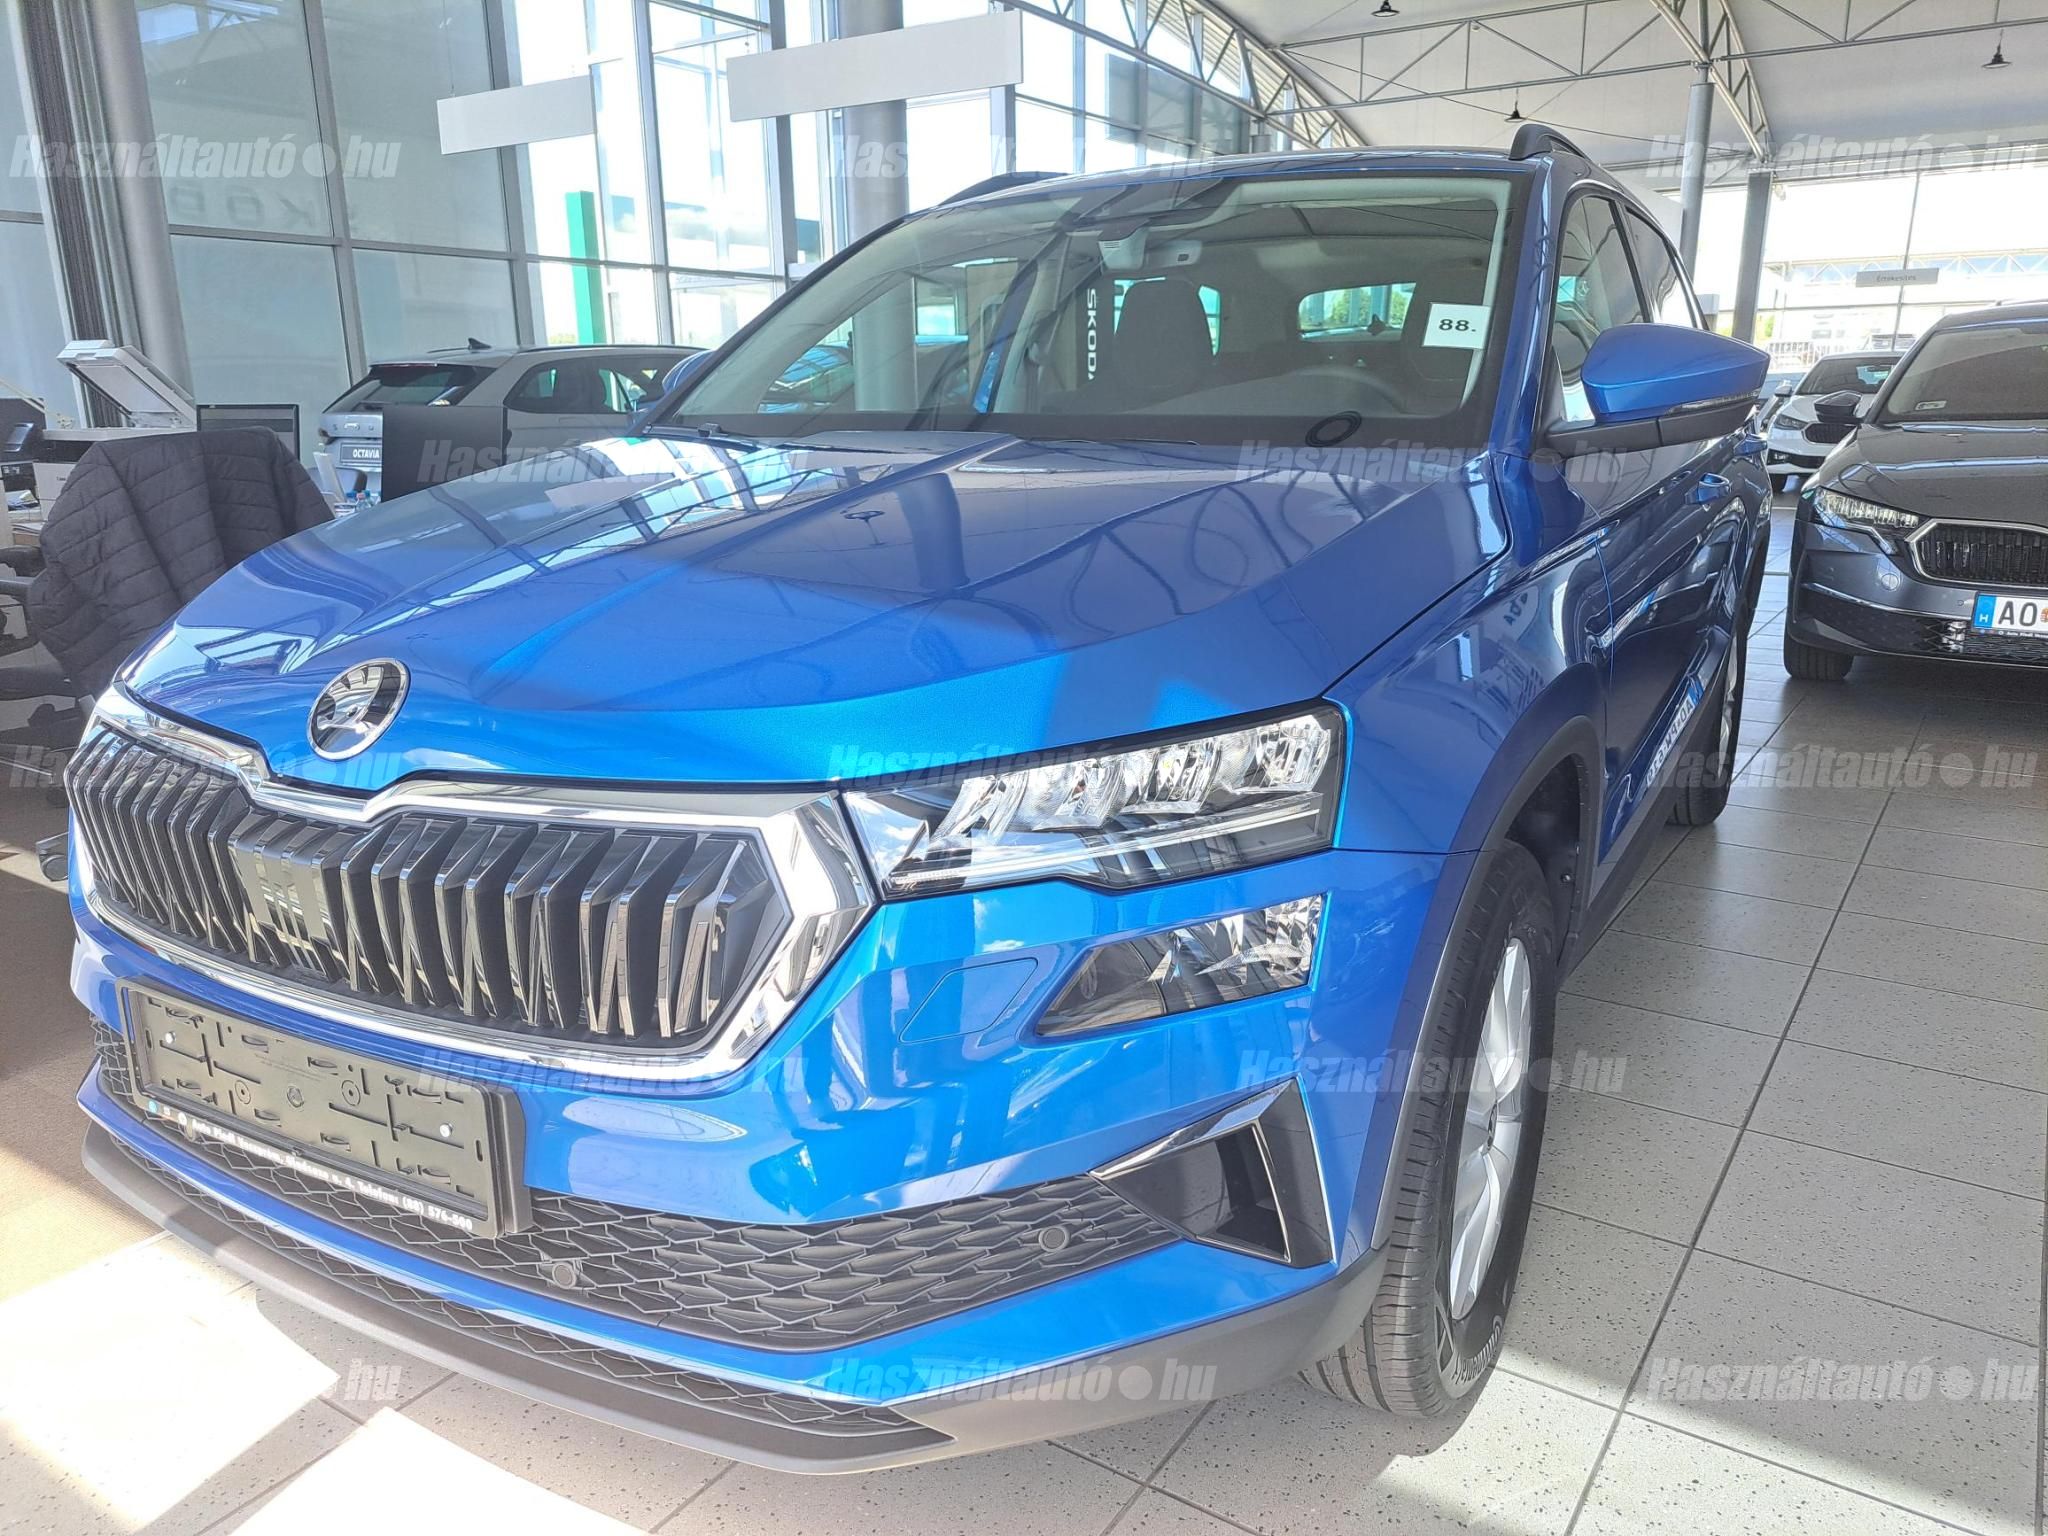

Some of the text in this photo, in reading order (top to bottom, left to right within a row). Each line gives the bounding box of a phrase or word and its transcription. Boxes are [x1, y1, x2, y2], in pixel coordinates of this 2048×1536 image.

[1439, 319, 1476, 331] 88.
[352, 448, 380, 459] OCTAVIA
[1979, 613, 1989, 623] H
[1998, 600, 2038, 627] AO
